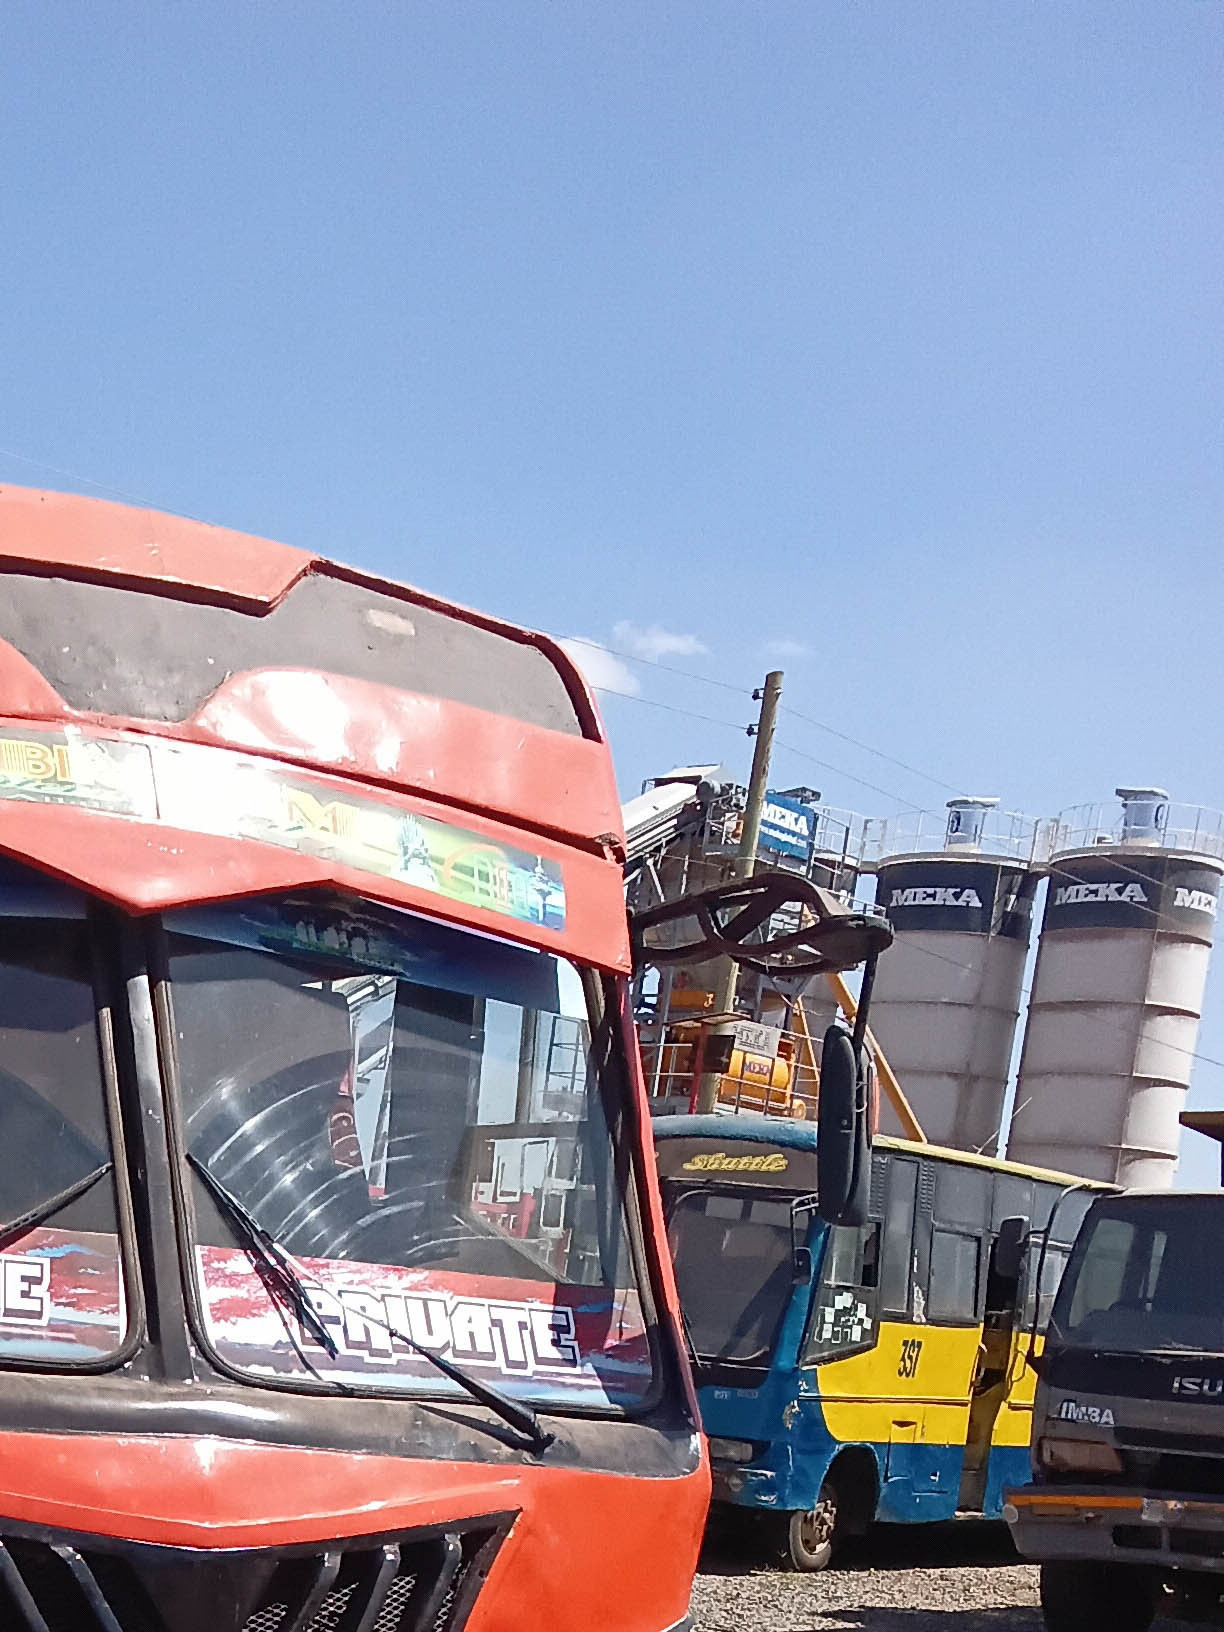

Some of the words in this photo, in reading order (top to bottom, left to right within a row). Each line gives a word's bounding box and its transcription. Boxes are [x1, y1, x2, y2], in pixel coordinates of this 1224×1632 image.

[760, 800, 809, 837] MEKA
[889, 887, 982, 908] MEKA
[1054, 882, 1149, 907] MEKA
